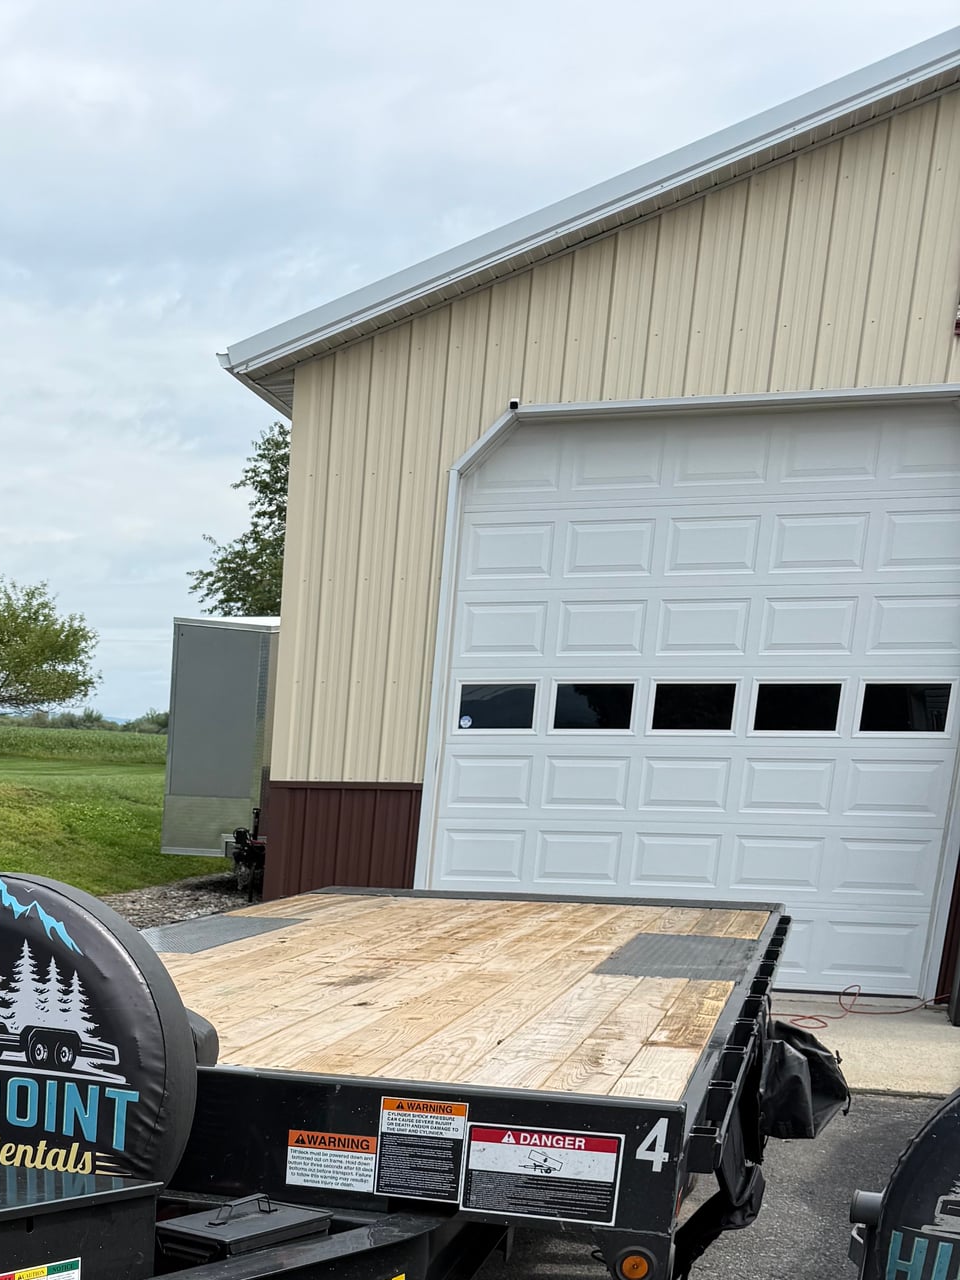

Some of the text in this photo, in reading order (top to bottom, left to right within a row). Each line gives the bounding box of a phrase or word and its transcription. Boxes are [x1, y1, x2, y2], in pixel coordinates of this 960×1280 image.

[406, 1102, 453, 1114] WARNING
[306, 1134, 370, 1151] WARNING
[519, 1133, 586, 1150] DANGER
[635, 1117, 669, 1172] 4
